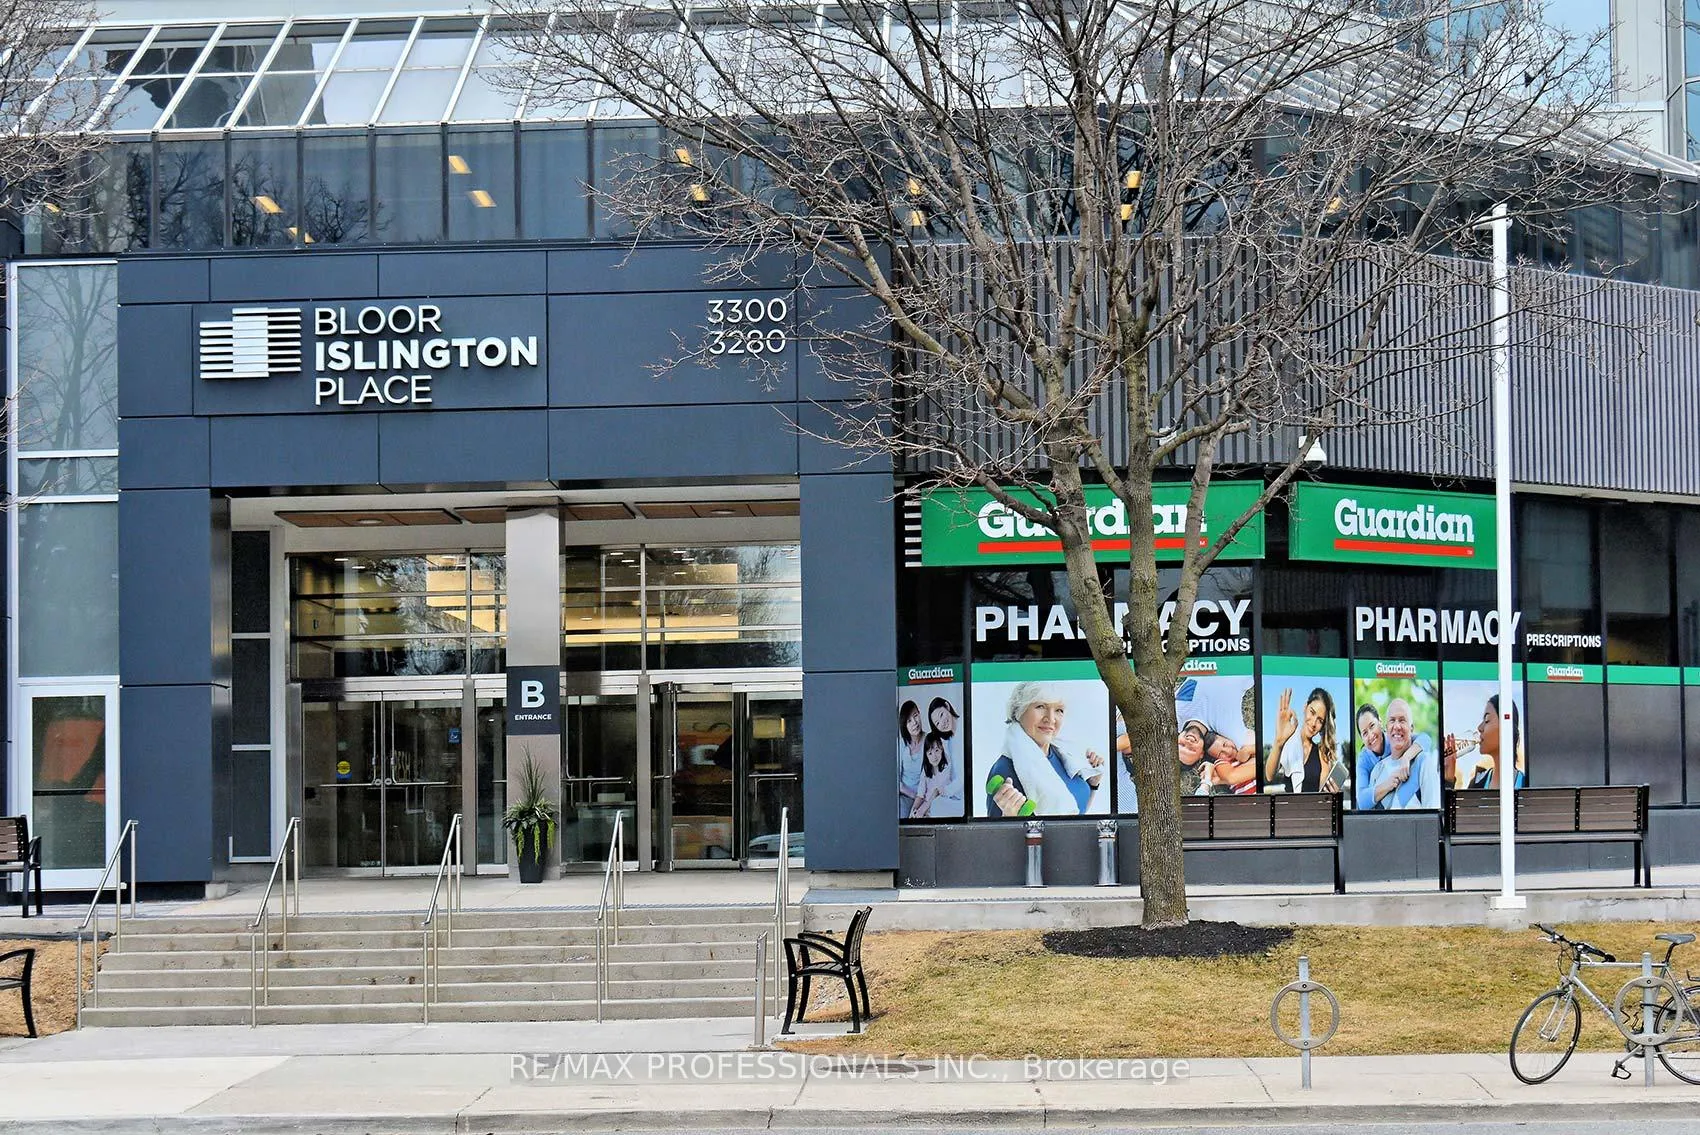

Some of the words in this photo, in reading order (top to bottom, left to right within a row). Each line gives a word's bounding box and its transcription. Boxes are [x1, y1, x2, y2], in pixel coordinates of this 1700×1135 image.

[314, 304, 443, 336] BLOOR
[707, 298, 788, 324] 3300
[314, 334, 539, 372] ISLINGTON
[709, 329, 787, 355] 3280
[314, 374, 434, 406] PLACE
[1333, 497, 1475, 543] Guardian
[1526, 632, 1602, 649] PRESCRIPTIONS
[908, 667, 954, 680] Guardian
[1375, 661, 1417, 675] Guardian
[1546, 665, 1584, 677] Guardian
[521, 680, 546, 709] B
[514, 713, 552, 721] ENTRANCE
